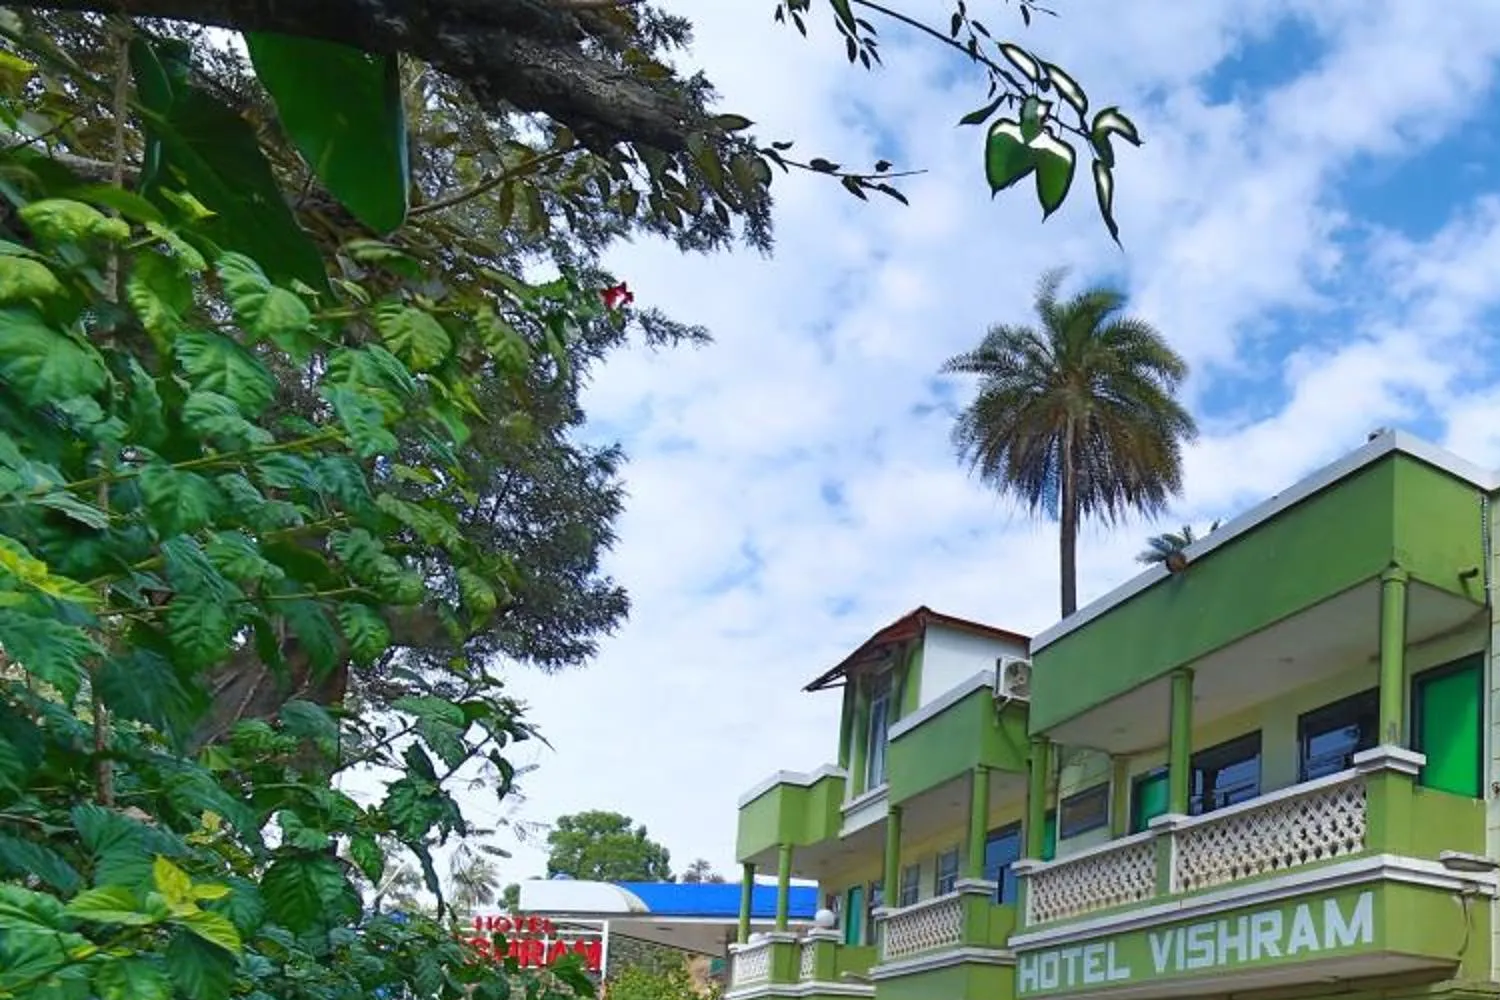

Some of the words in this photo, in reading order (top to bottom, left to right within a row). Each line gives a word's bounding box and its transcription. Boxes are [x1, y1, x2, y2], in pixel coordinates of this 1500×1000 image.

[472, 914, 557, 934] HOTEL
[1018, 941, 1132, 993] HOTEL
[1148, 891, 1374, 974] VISHRAM
